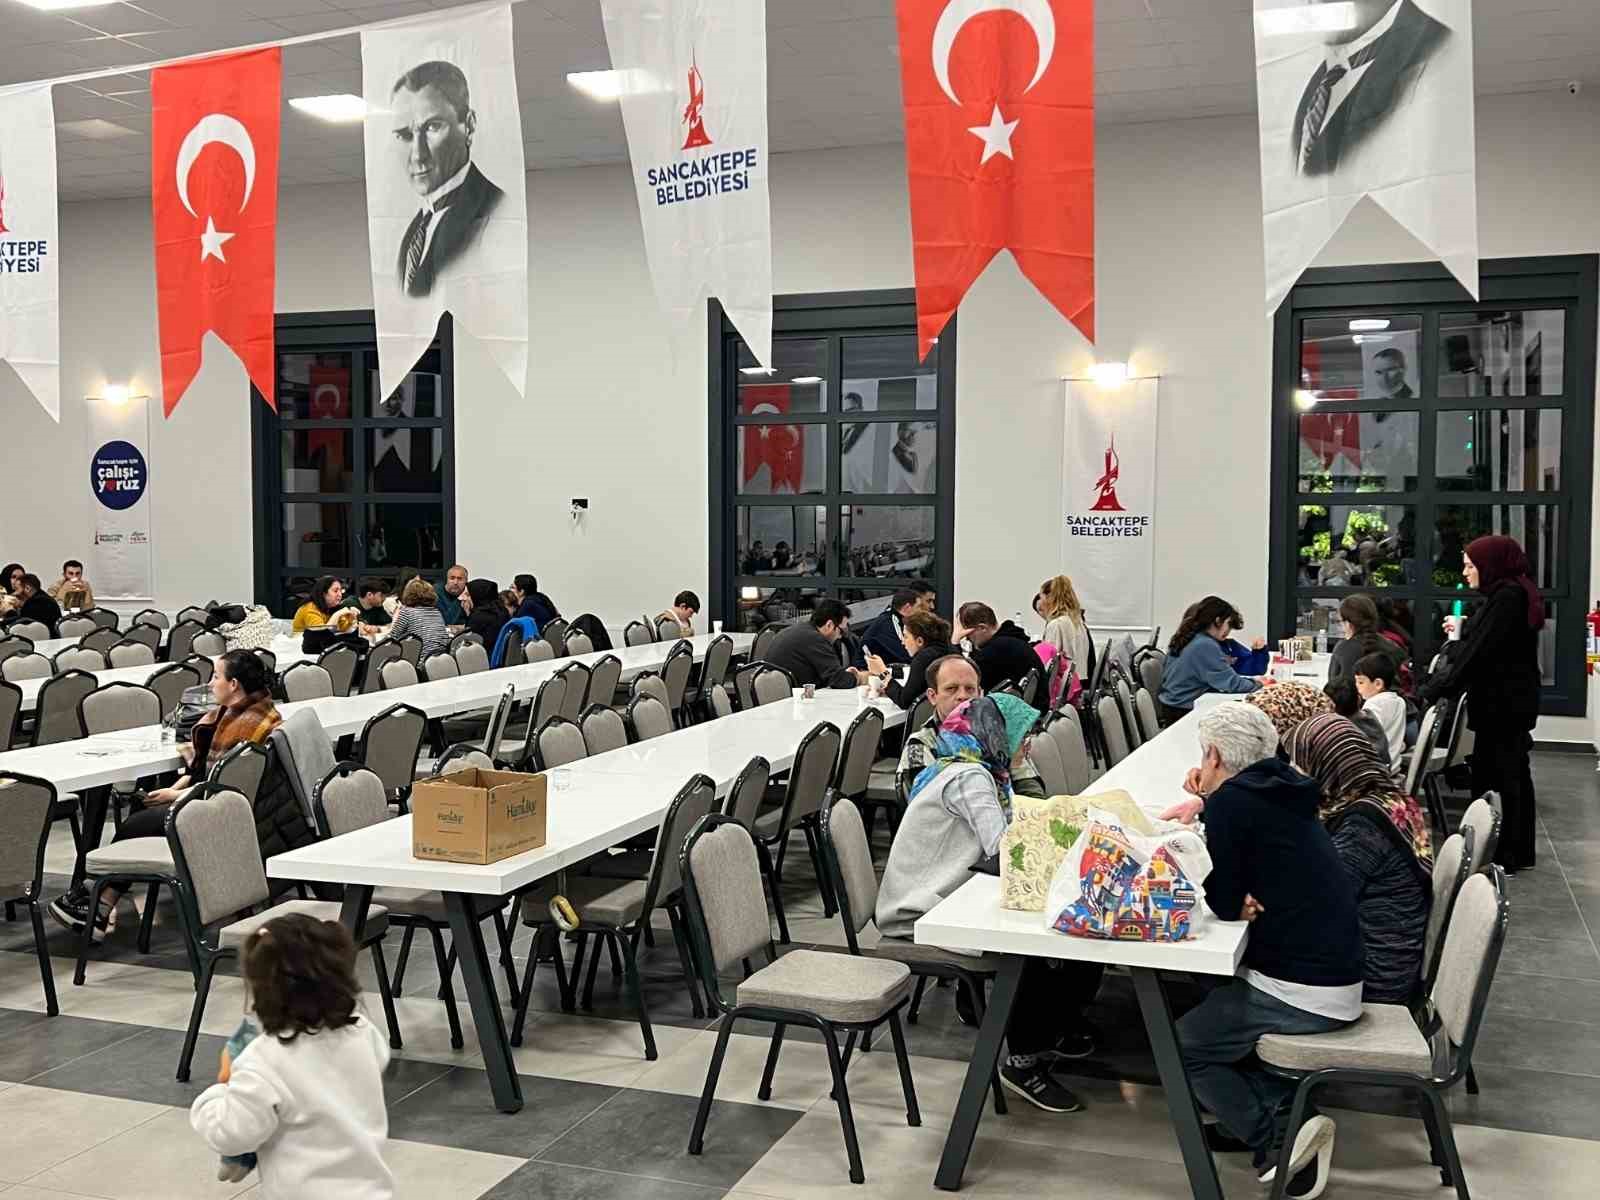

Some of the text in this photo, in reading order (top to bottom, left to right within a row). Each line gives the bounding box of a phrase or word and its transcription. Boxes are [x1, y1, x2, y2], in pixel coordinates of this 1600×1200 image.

[647, 148, 757, 186] SANCAKTEPE
[656, 170, 749, 205] BELEDİYESİ
[97, 465, 139, 480] çalışı-
[1066, 515, 1149, 526] SANCAKTEPE
[1071, 526, 1143, 537] BELEDİYESİ
